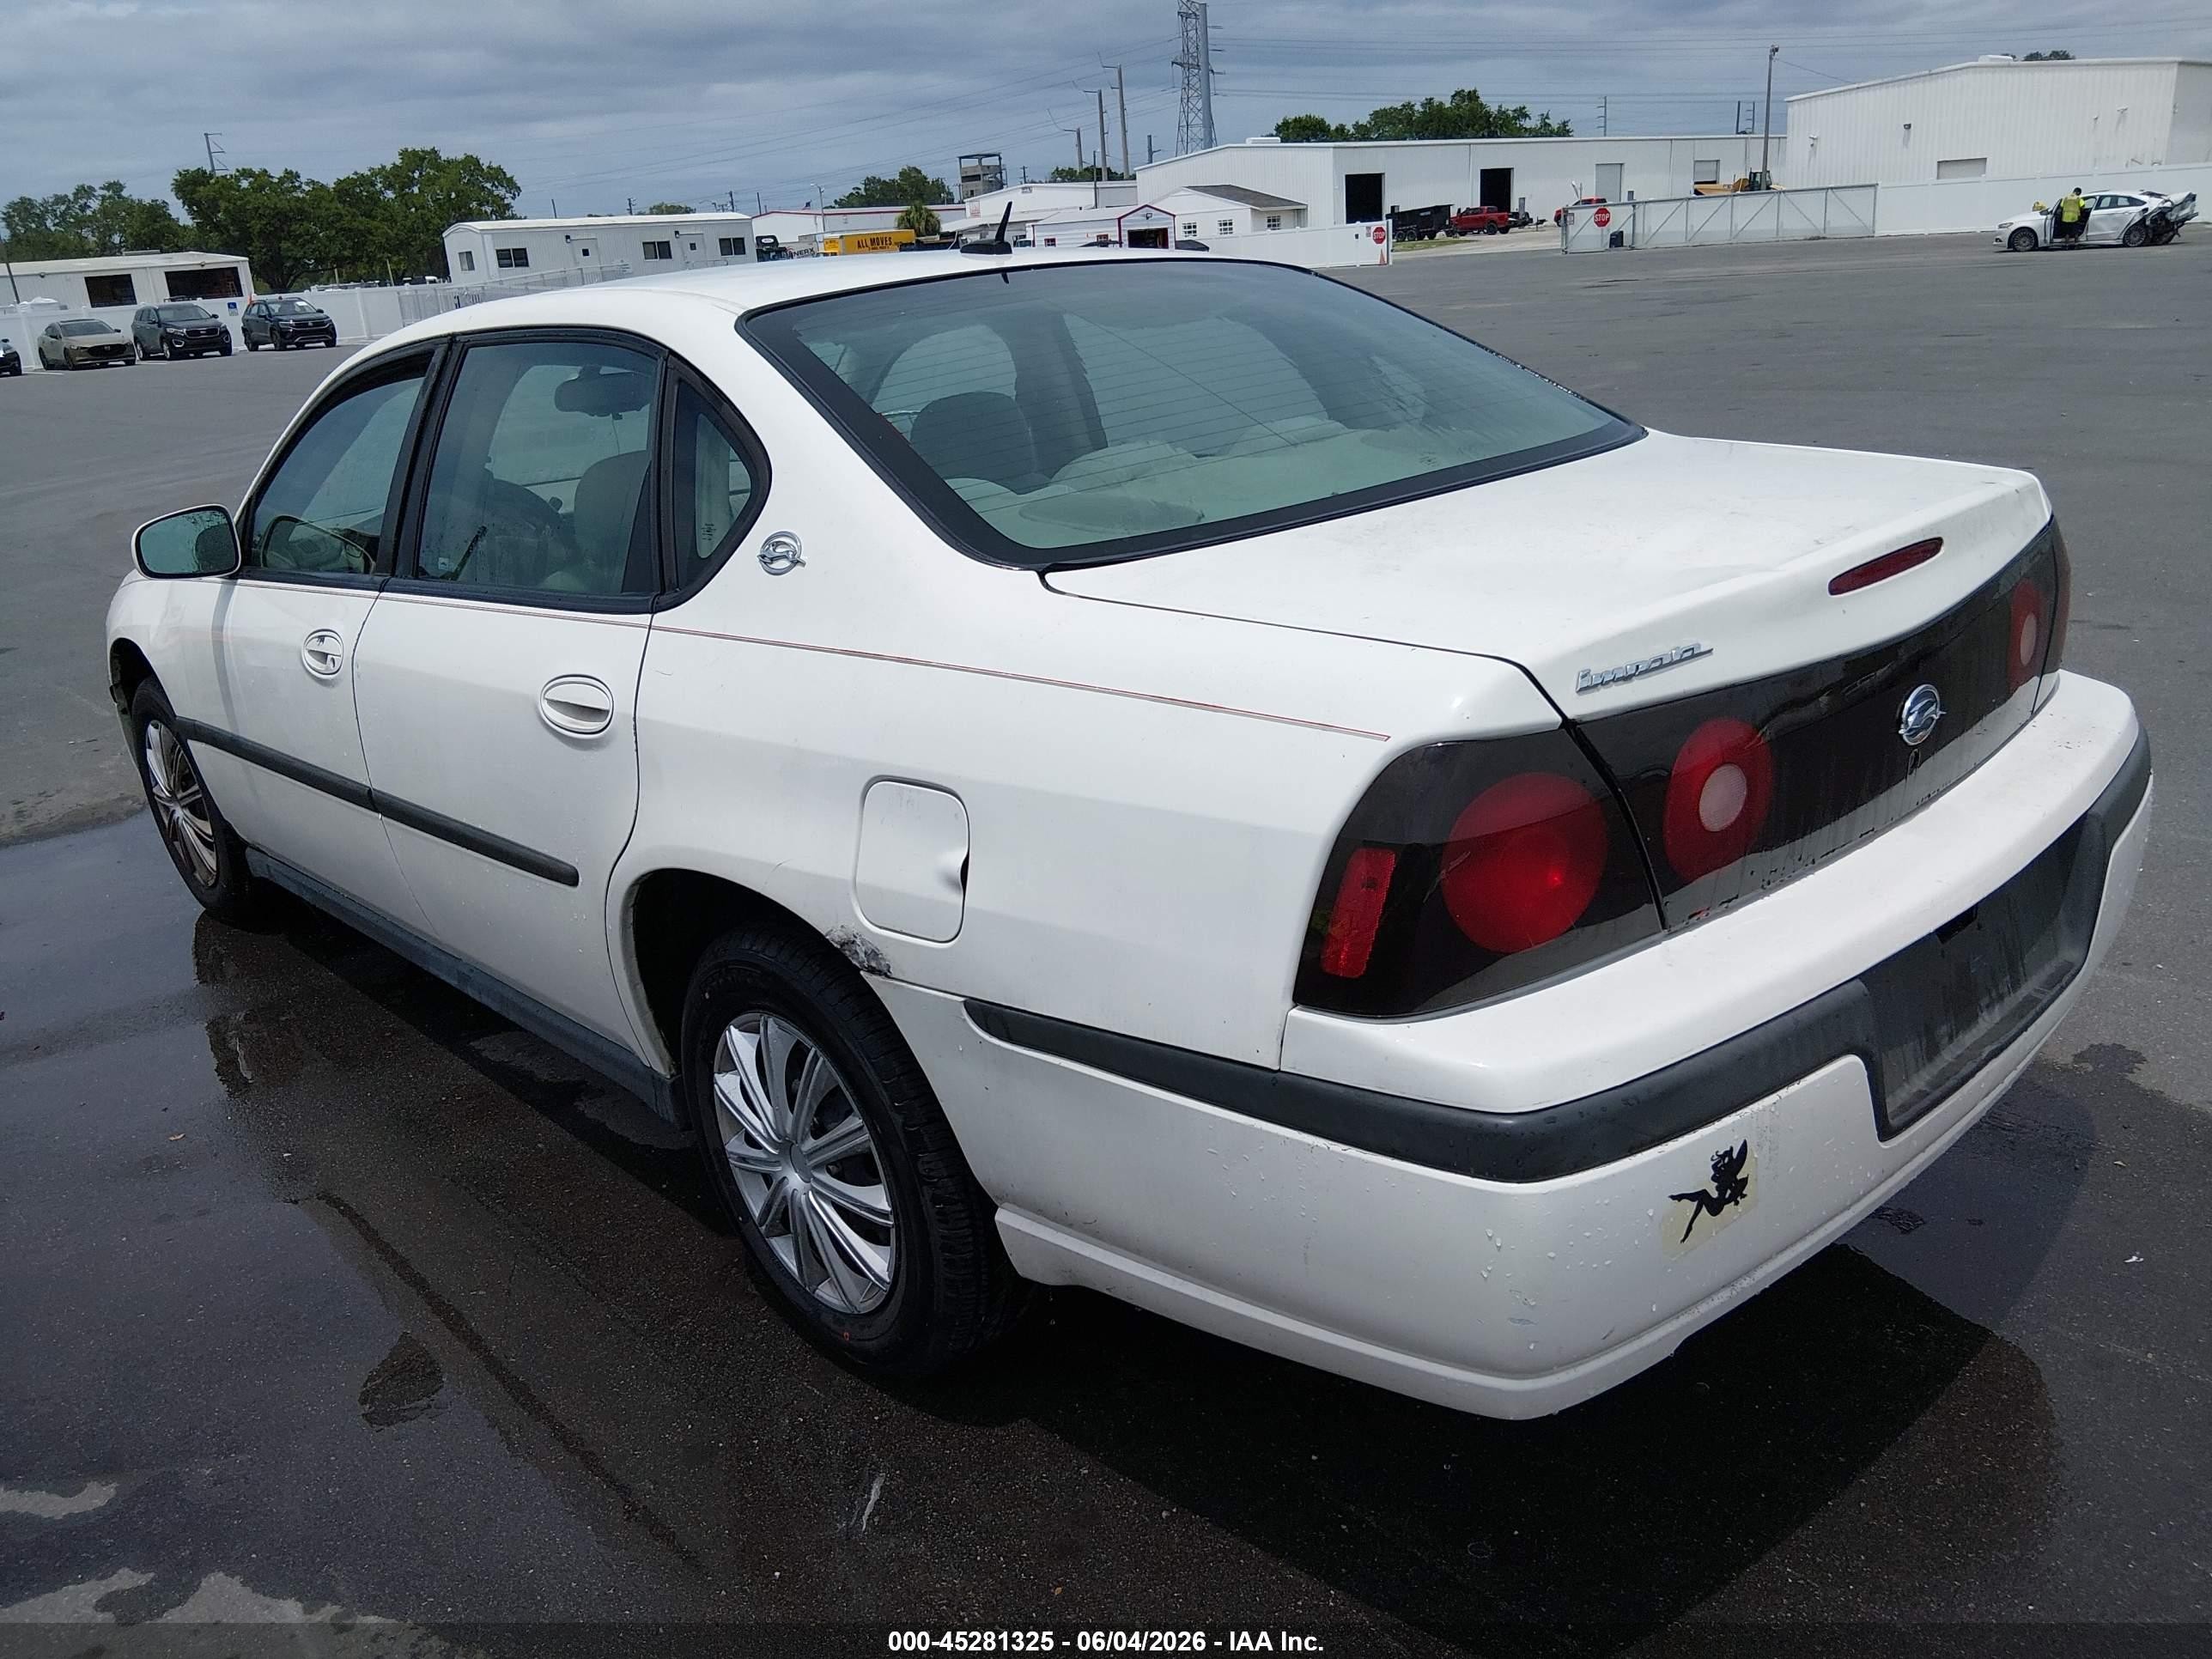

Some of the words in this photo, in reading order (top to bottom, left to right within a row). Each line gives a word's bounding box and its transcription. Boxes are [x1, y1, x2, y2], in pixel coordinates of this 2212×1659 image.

[1595, 213, 1610, 222] STOP
[1374, 231, 1385, 240] STOP
[857, 239, 868, 248] ALL
[870, 236, 892, 246] MOVES
